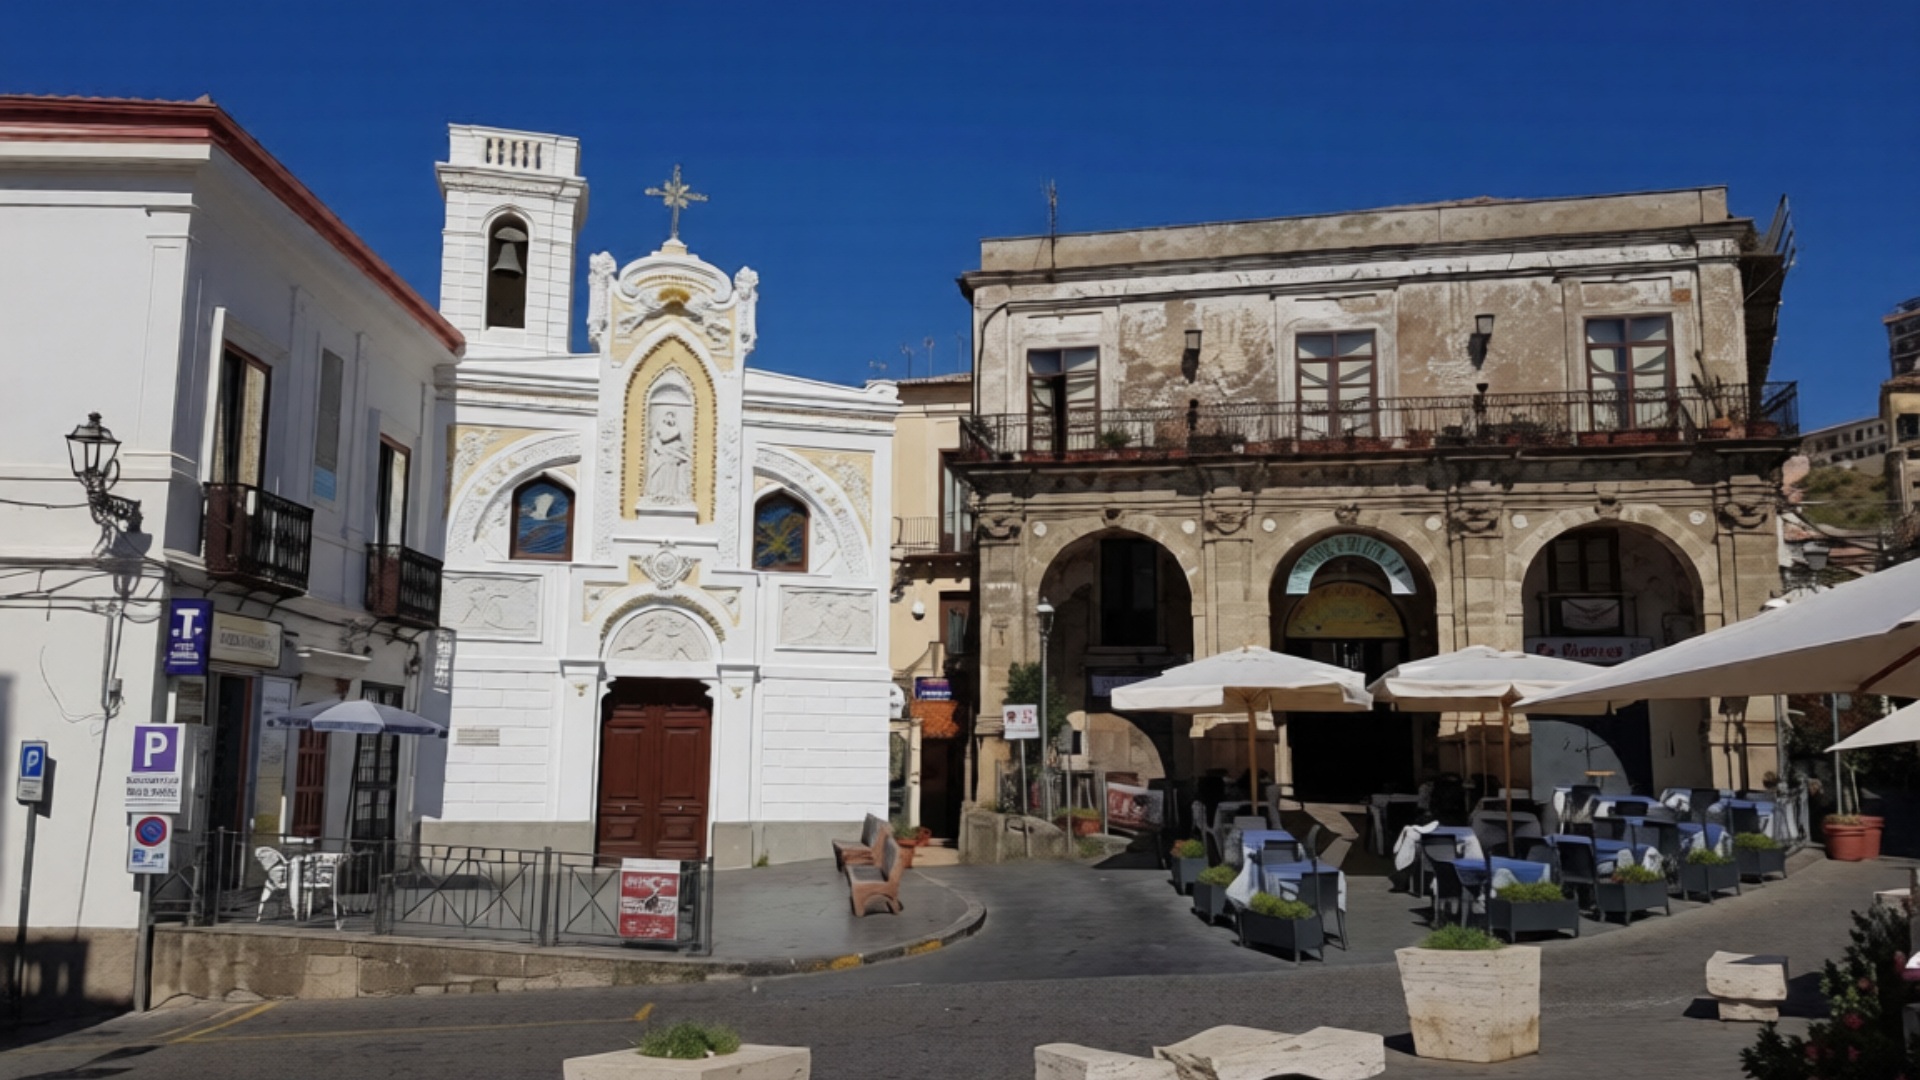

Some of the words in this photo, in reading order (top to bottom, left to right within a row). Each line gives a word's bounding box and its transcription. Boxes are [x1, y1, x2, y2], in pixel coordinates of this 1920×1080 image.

[176, 608, 200, 639] T
[26, 750, 39, 773] P
[144, 731, 168, 767] P
